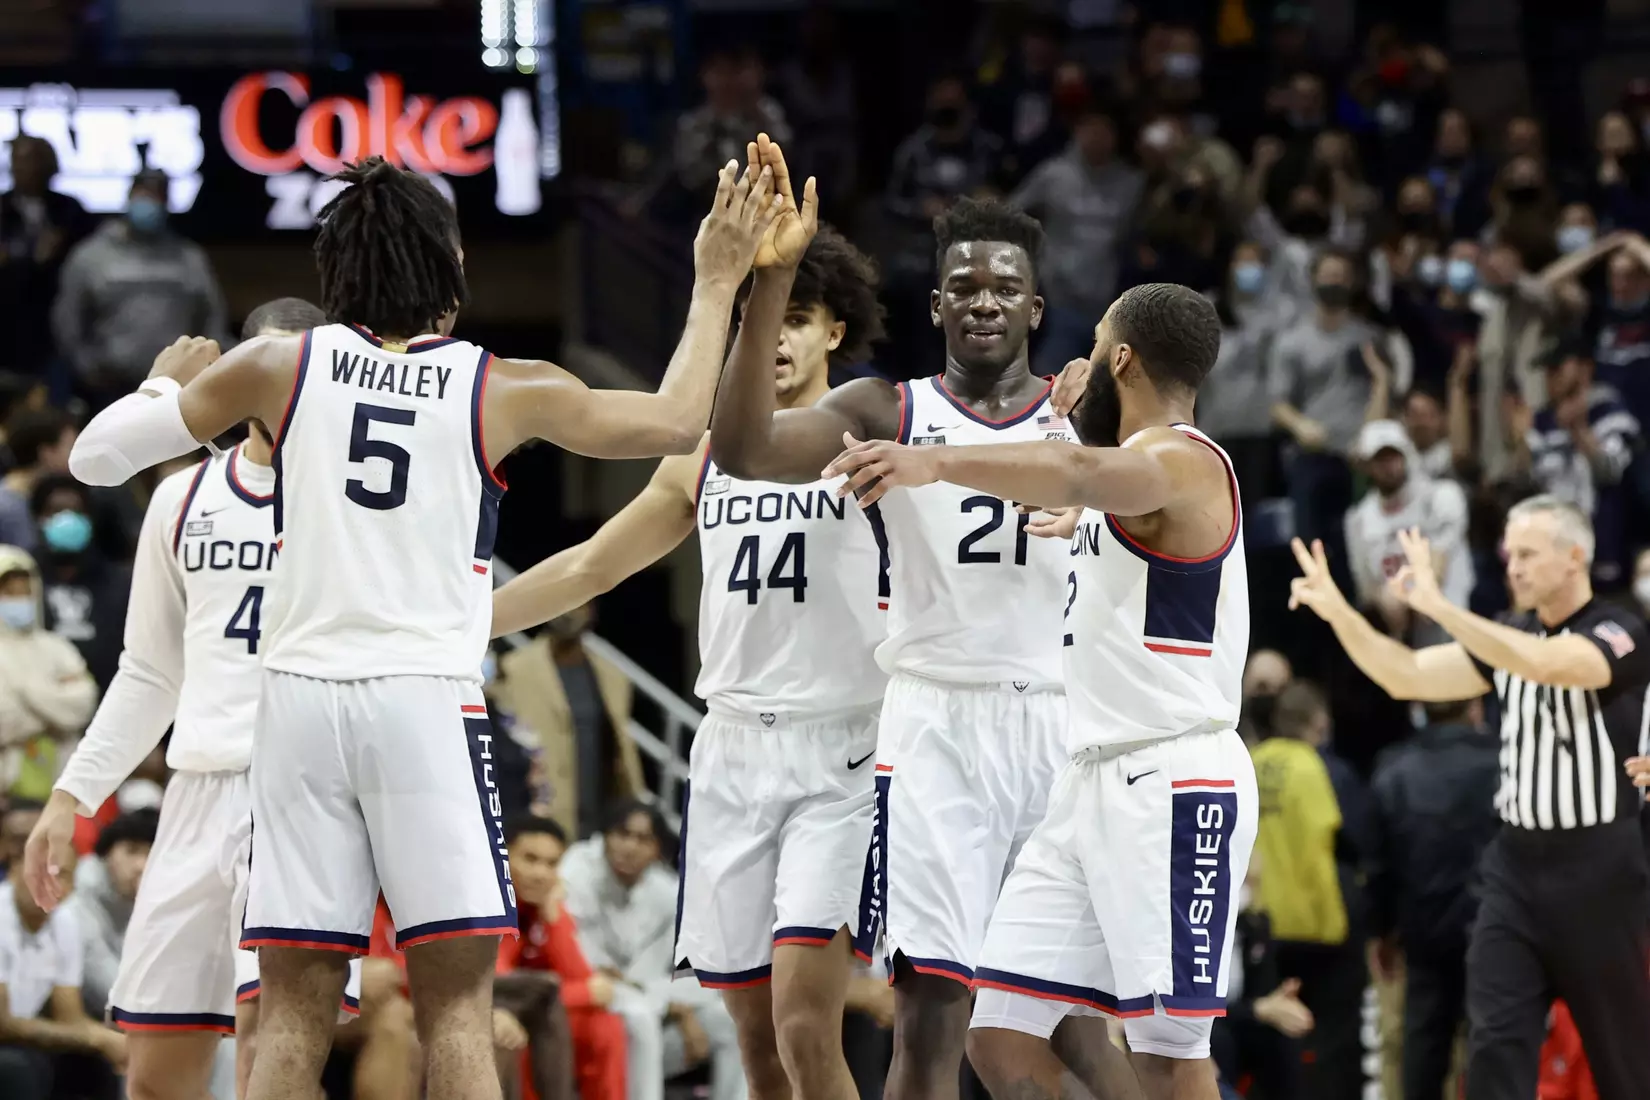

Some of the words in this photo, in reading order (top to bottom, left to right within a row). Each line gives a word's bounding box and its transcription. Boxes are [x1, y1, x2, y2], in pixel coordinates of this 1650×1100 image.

[219, 71, 499, 175] Coke
[332, 349, 452, 400] WHALEY
[345, 402, 417, 510] 5
[703, 490, 845, 529] UCONN
[957, 495, 1030, 565] 21
[727, 532, 808, 605] 44
[224, 585, 265, 655] 4
[477, 734, 518, 909] HUSKIES
[1188, 803, 1224, 985] HUSKIES
